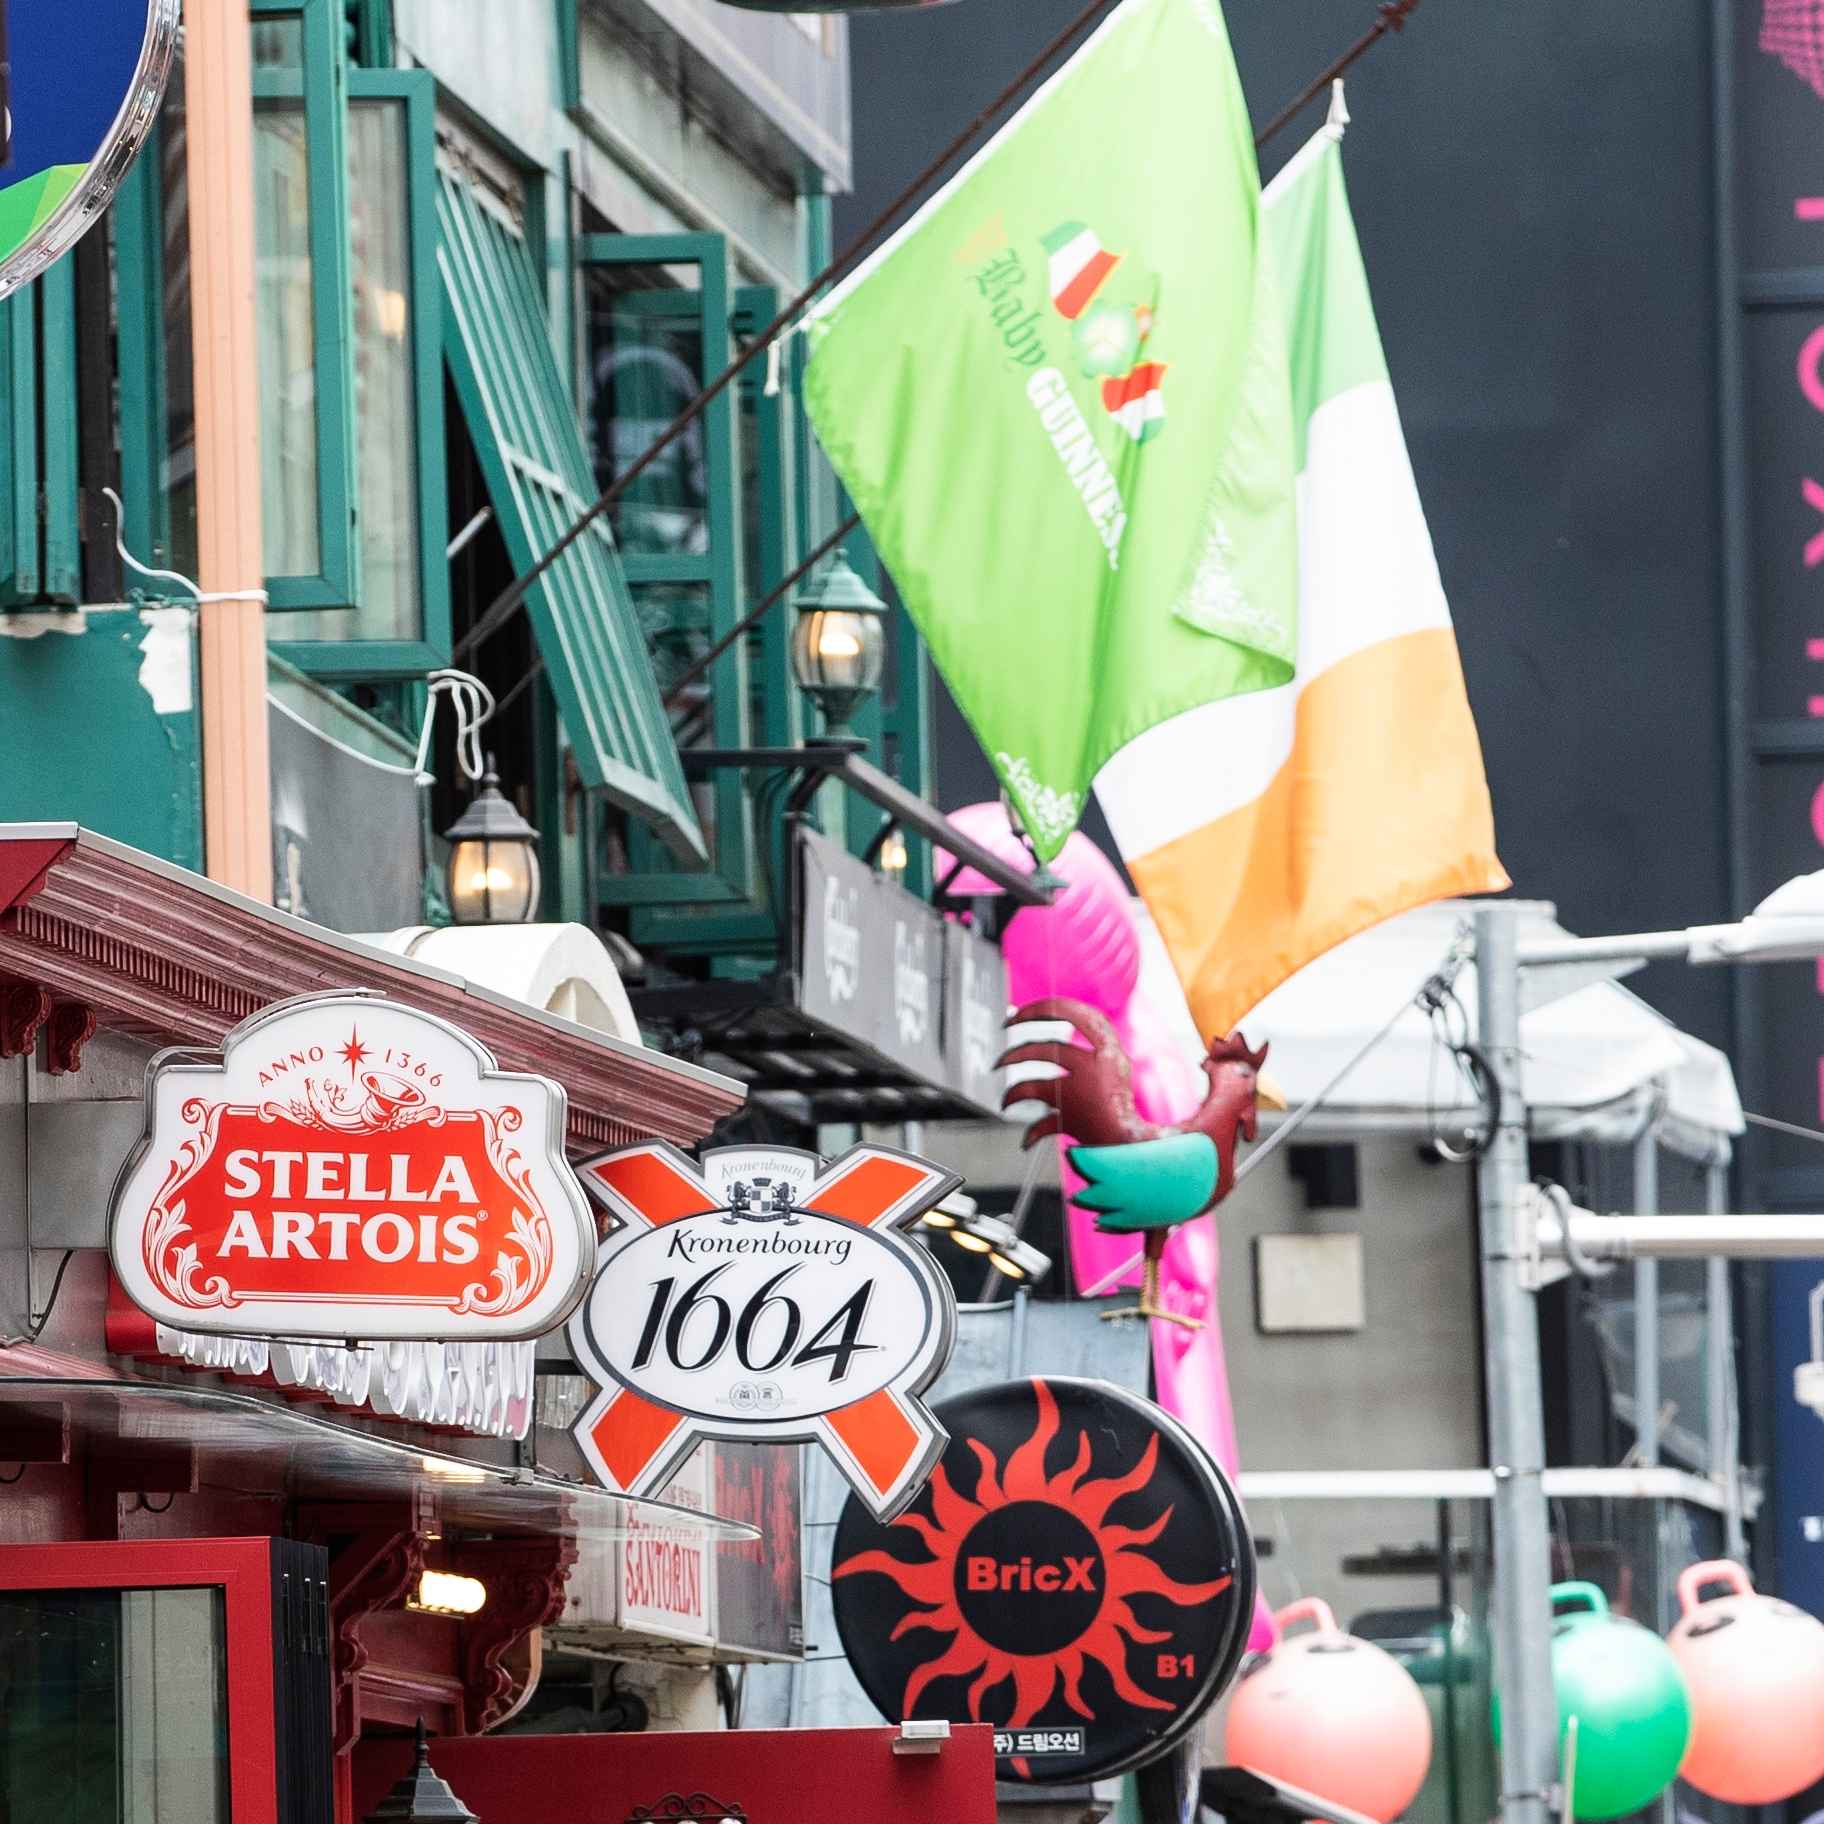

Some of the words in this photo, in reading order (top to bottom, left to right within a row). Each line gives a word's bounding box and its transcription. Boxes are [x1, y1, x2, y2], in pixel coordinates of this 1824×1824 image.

[978, 248, 1047, 367] Baby
[258, 1046, 323, 1087] ANNO
[385, 1048, 444, 1087] 1366
[223, 1150, 481, 1203] STELLA
[721, 1159, 808, 1180] Kronenbourg
[217, 1209, 479, 1264] ARTOIS
[667, 1229, 852, 1265] Kronenbourg
[630, 1261, 879, 1382] 1664
[967, 1556, 1096, 1592] BricX
[1157, 1653, 1195, 1679] B1
[1017, 1732, 1080, 1752] 드림오션
